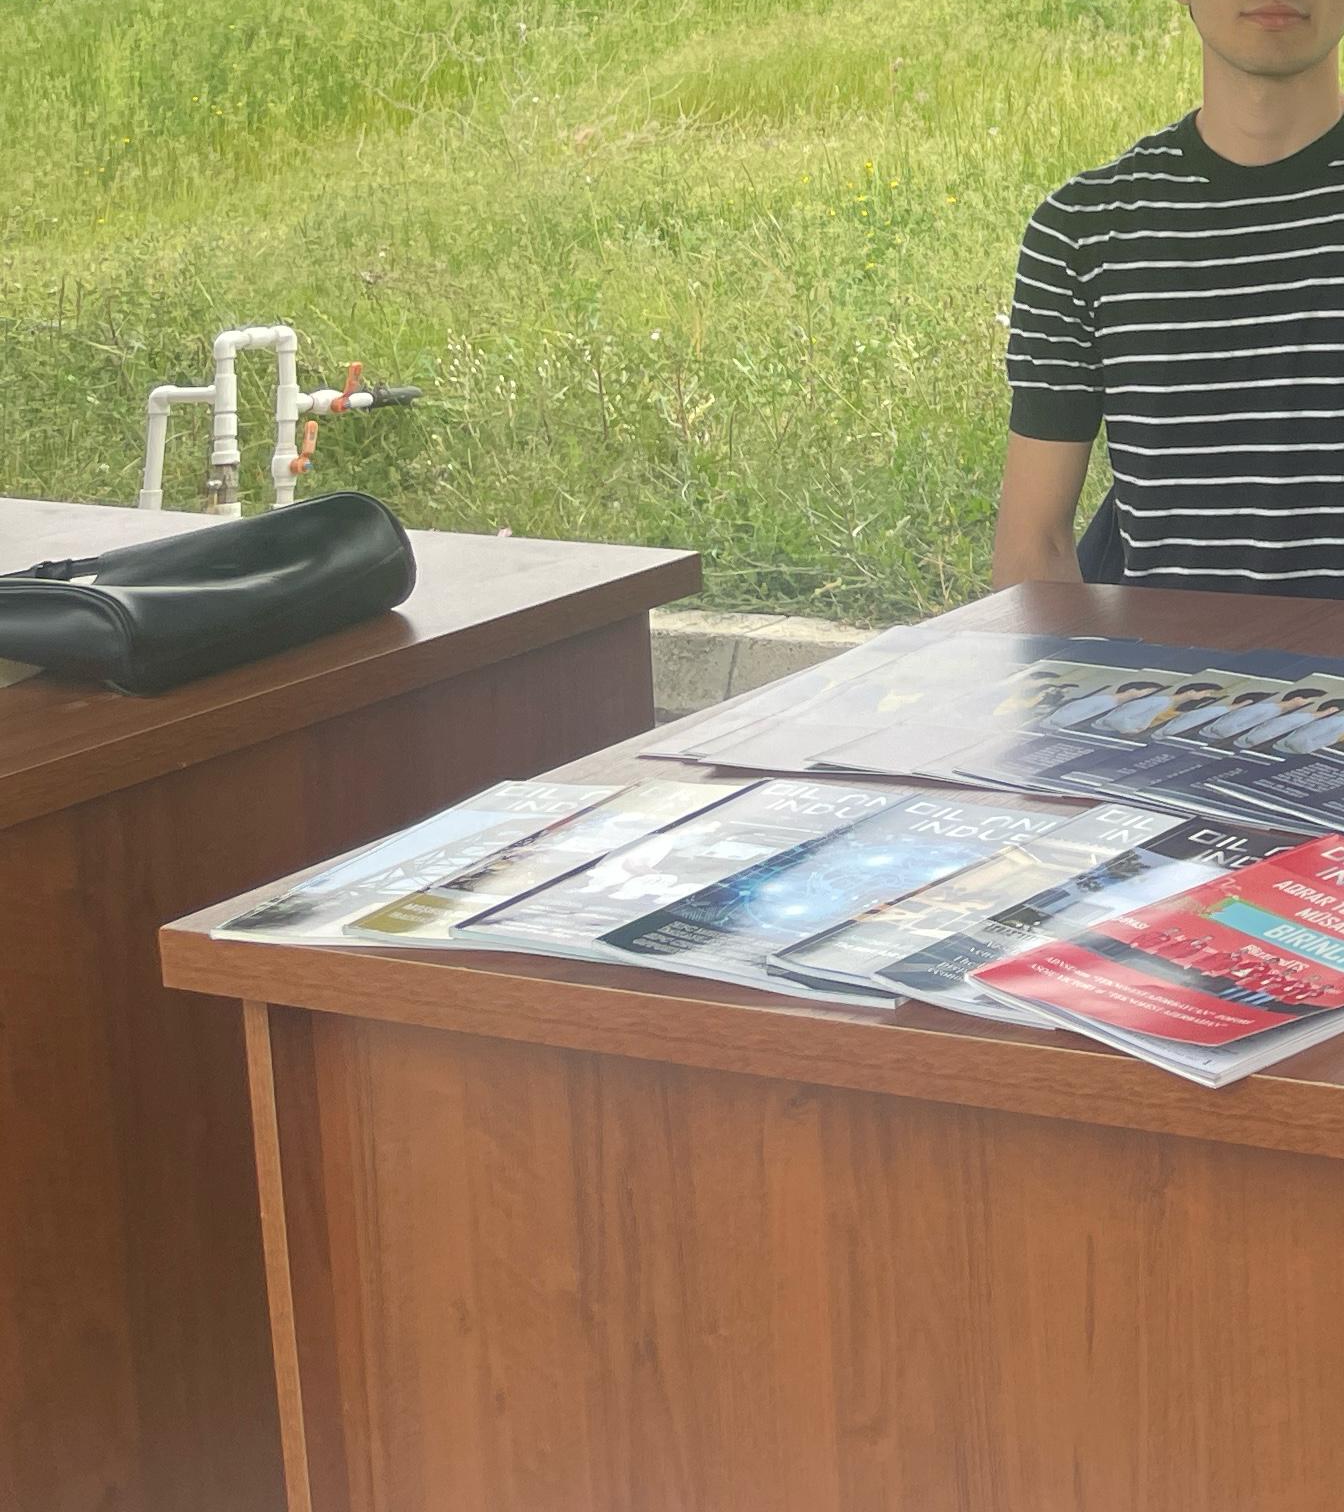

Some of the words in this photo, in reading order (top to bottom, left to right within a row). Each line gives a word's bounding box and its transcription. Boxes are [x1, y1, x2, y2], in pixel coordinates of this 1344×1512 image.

[761, 783, 823, 801] OIL
[905, 801, 964, 822] OIL
[1095, 809, 1155, 831] OIL
[1188, 829, 1249, 853] OIL
